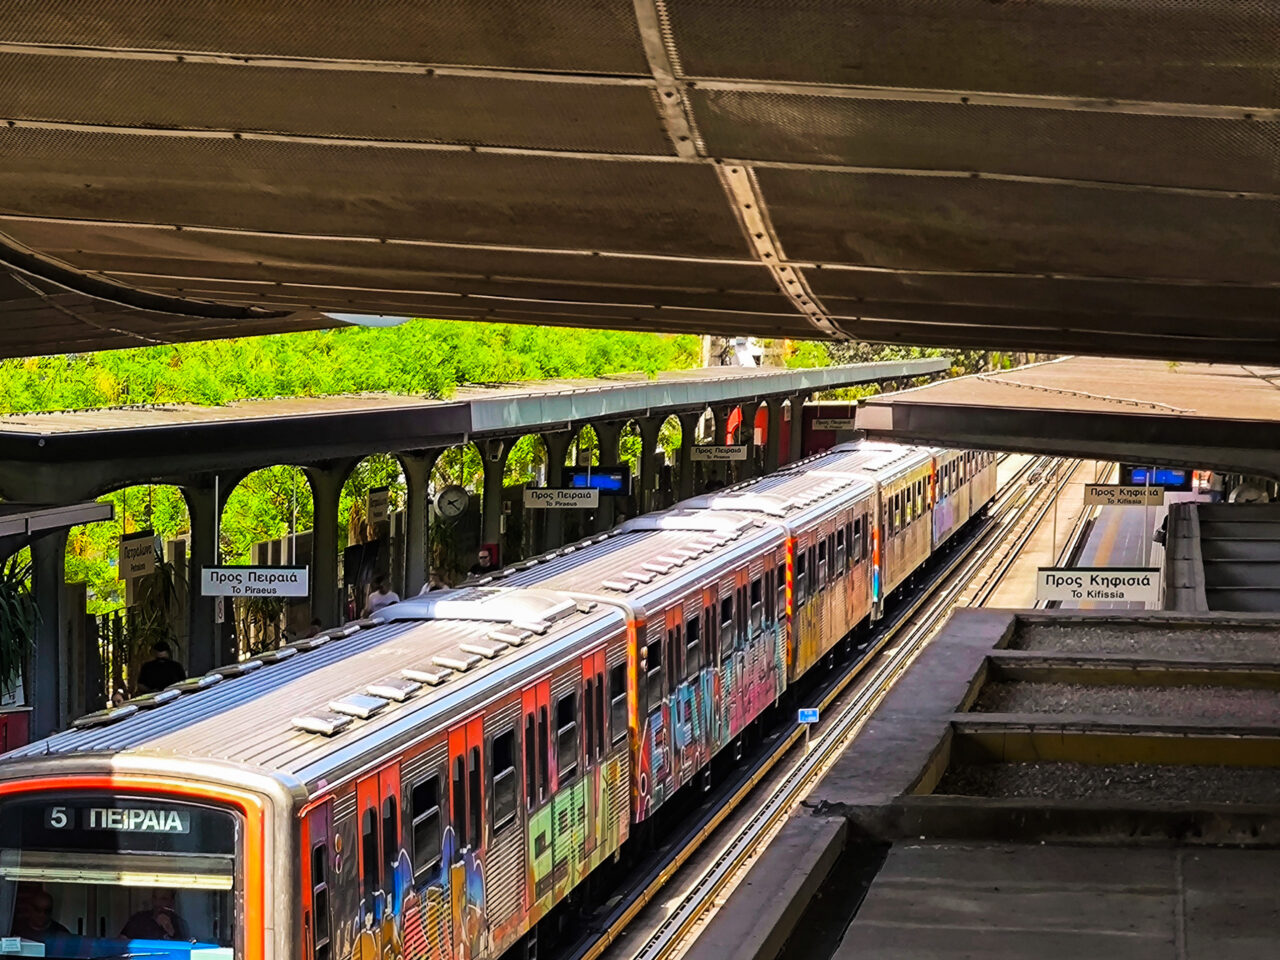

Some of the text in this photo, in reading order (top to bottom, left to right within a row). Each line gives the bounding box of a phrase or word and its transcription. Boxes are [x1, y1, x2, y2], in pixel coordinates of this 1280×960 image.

[531, 492, 553, 500] Προς
[1091, 488, 1114, 497] Προς
[210, 572, 298, 584] Προς Πειραιά
[1045, 574, 1151, 588] Προς Κηφισιά
[232, 586, 277, 594] To Piraeus
[1071, 590, 1125, 598] To Kifissia
[50, 807, 183, 831] 5 ΠΕΙΡΑΙΑ
